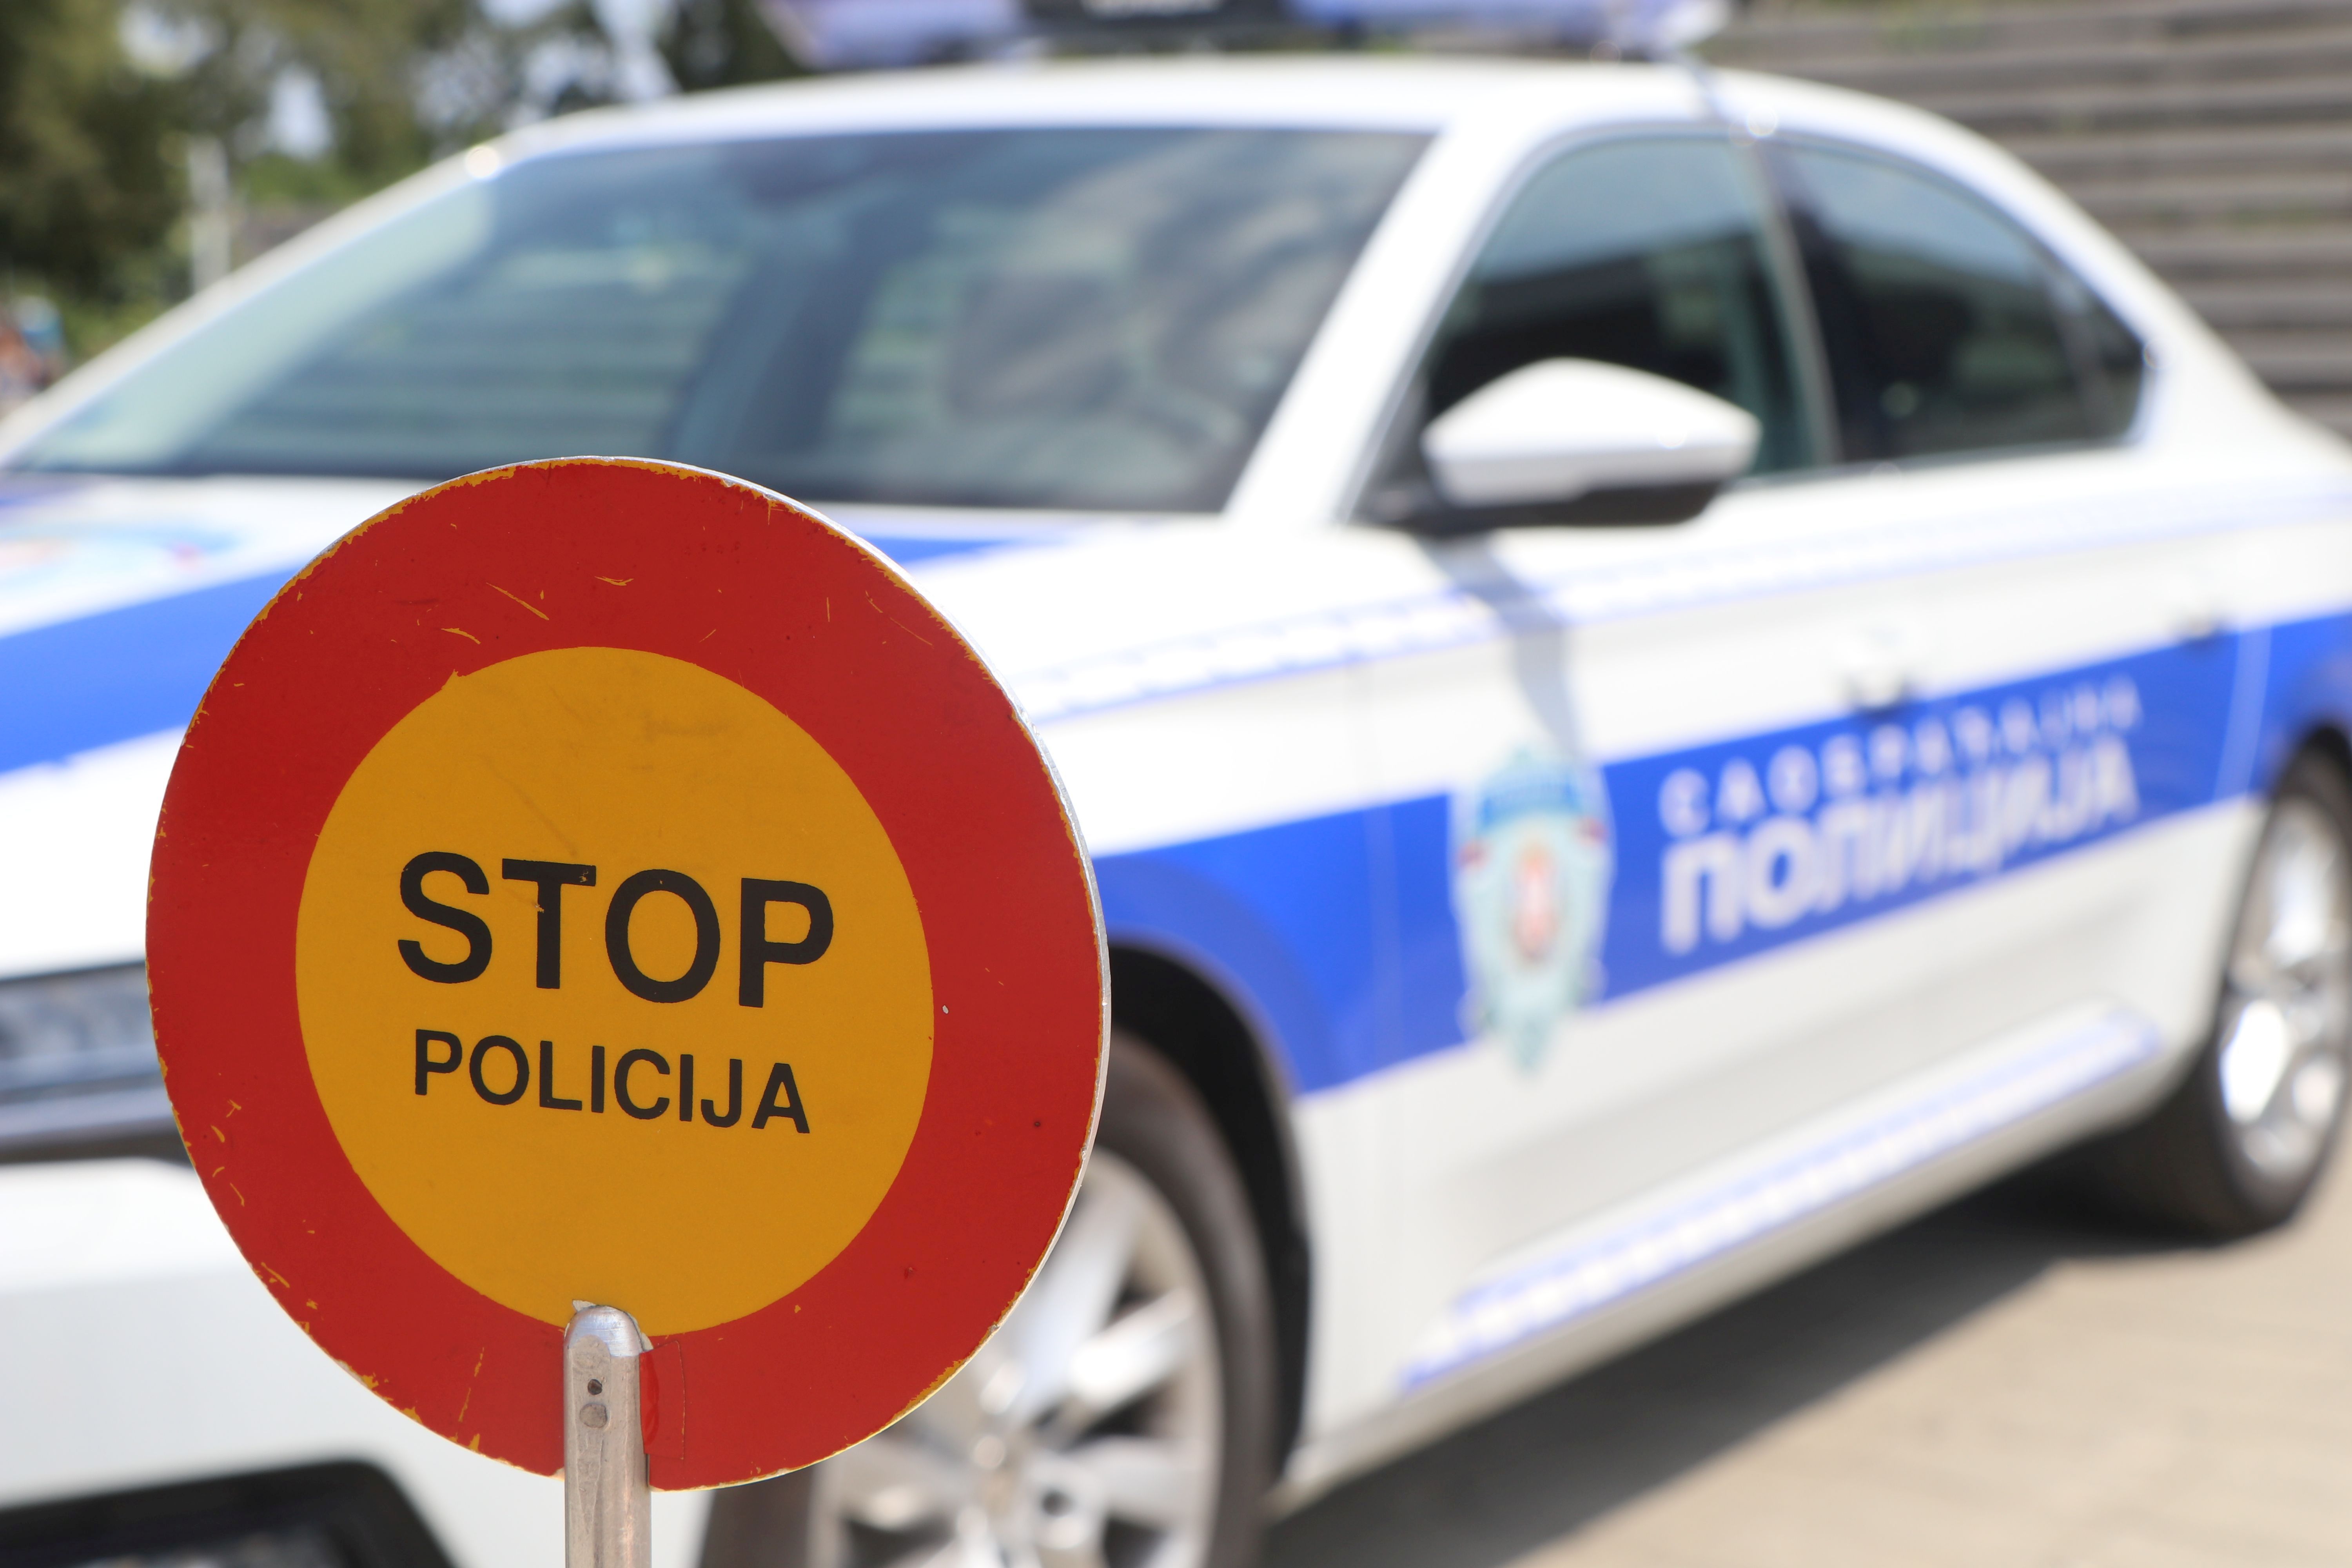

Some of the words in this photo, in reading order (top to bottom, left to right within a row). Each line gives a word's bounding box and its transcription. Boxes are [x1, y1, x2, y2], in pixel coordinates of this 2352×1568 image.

[1661, 737, 2139, 955] ПОЛИЦИЈА
[398, 851, 833, 1007] STOP
[416, 1029, 809, 1133] POLICIJA
